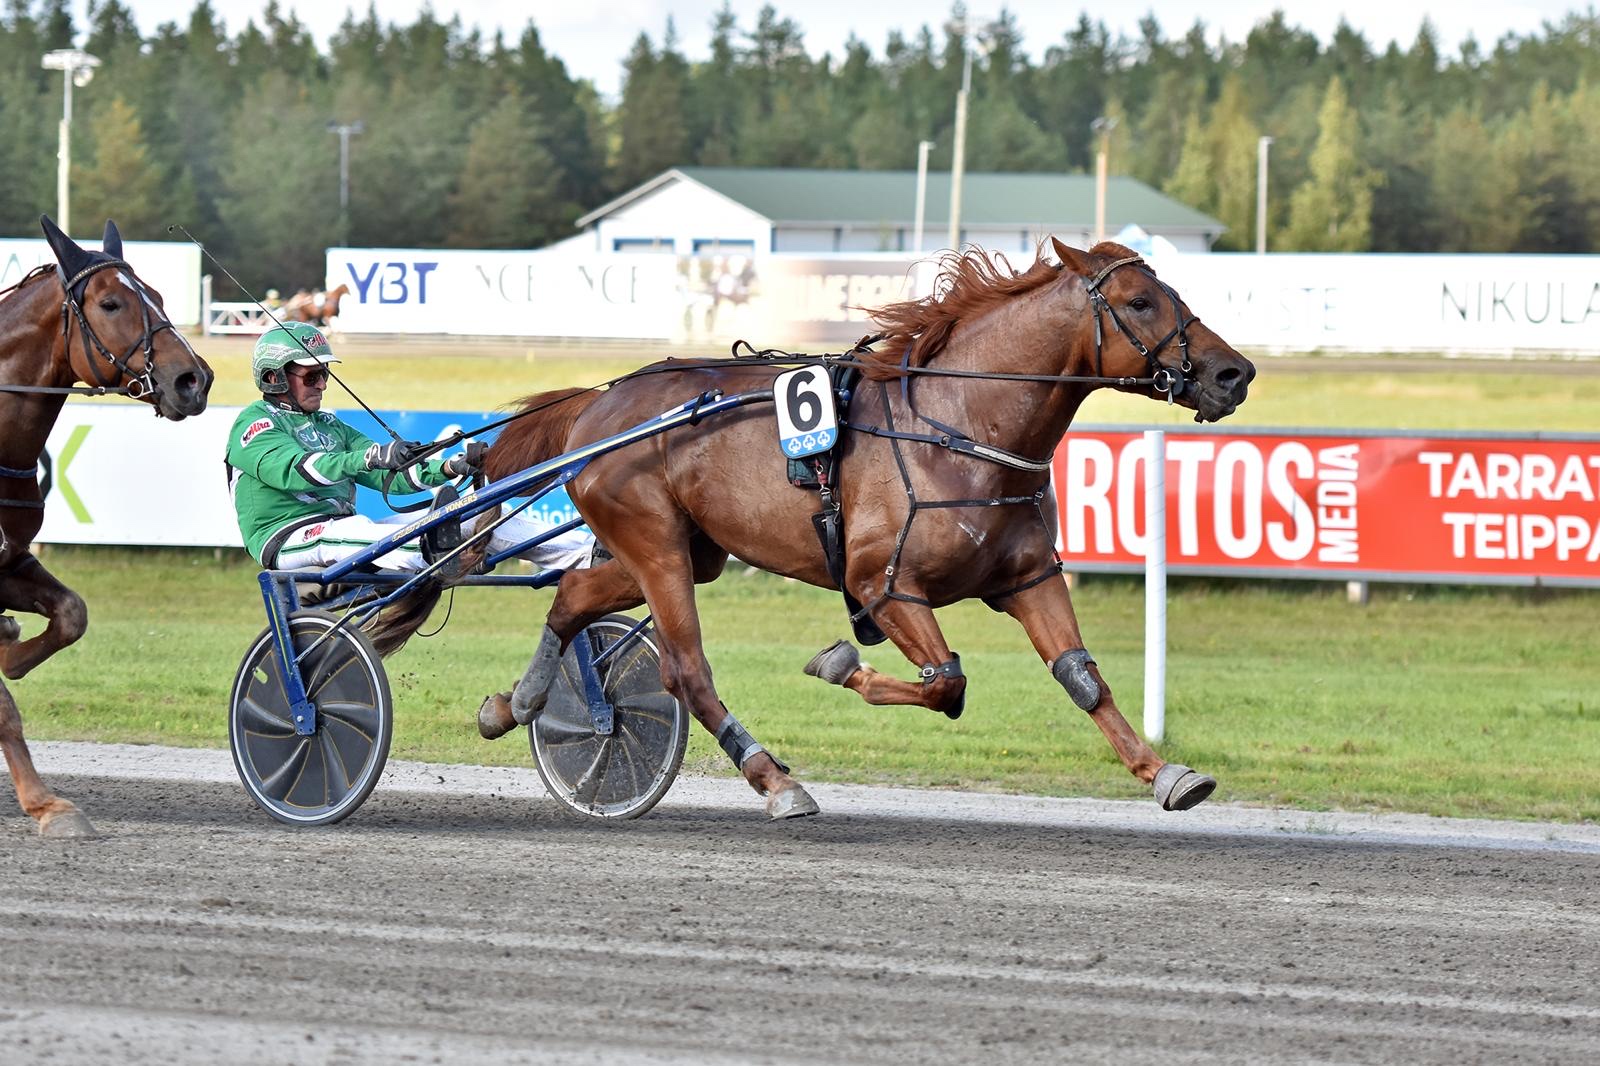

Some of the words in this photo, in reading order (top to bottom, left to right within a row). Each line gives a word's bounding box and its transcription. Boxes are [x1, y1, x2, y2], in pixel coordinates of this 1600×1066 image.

[346, 262, 439, 304] YBT
[787, 371, 822, 432] 6
[1050, 438, 1316, 561] ROTOS
[1318, 443, 1360, 563] MEDIA
